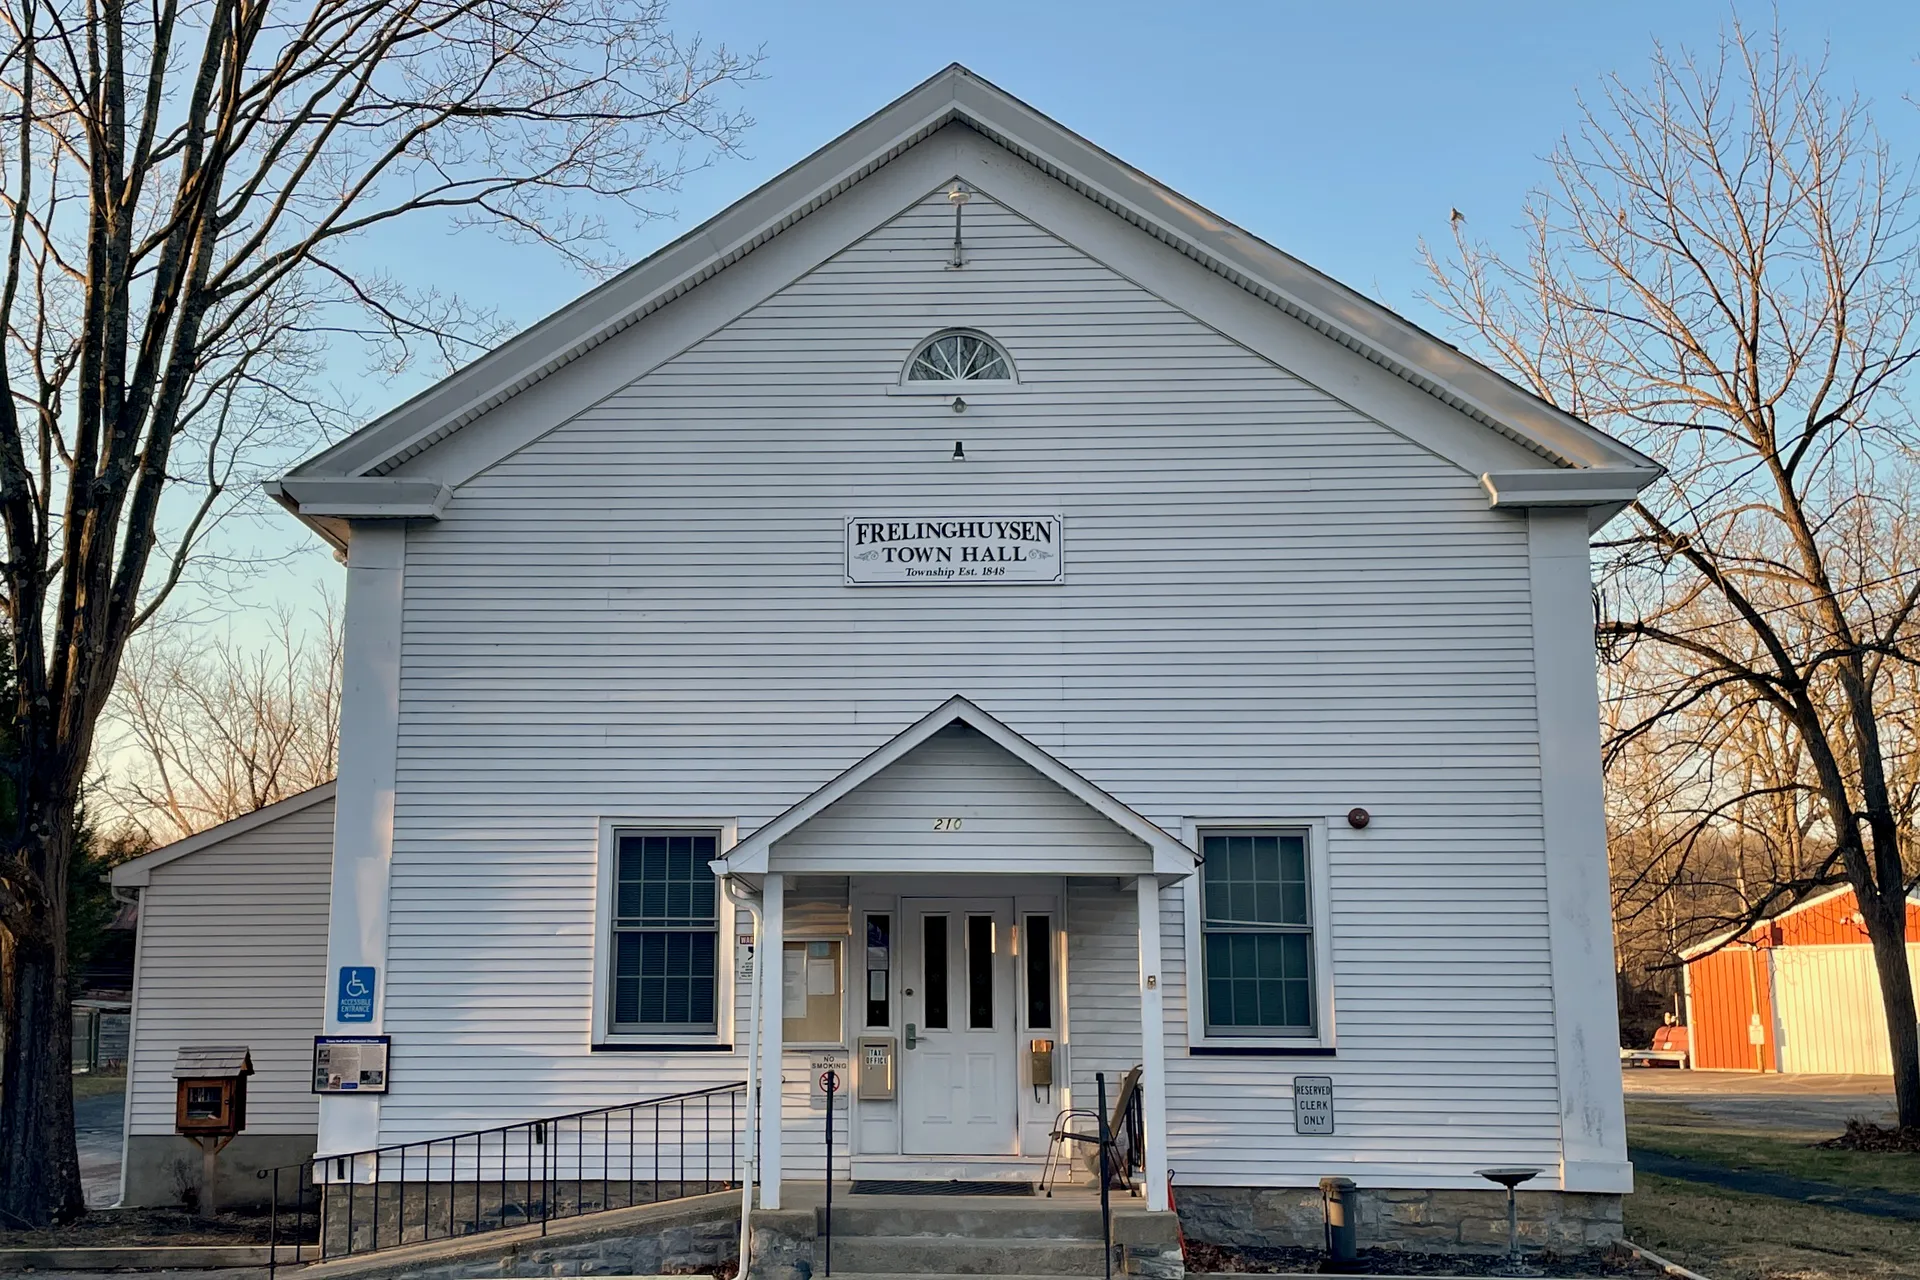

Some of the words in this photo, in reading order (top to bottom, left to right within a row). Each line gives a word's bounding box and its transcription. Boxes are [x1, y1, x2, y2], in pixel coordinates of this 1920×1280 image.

[855, 520, 1053, 546] FRELINGHUYSEN
[882, 546, 953, 563] TOWN
[961, 546, 1027, 562] HALL
[905, 567, 955, 579] Township
[958, 567, 978, 576] Est.
[982, 566, 1006, 576] 1848
[933, 817, 962, 830] 210
[341, 998, 371, 1006] ACCESSIBLE
[341, 1005, 370, 1013] ENTRANCE
[1296, 1085, 1331, 1095] RESERVED
[1300, 1100, 1328, 1110] CLERK
[1303, 1115, 1326, 1125] ONLY
